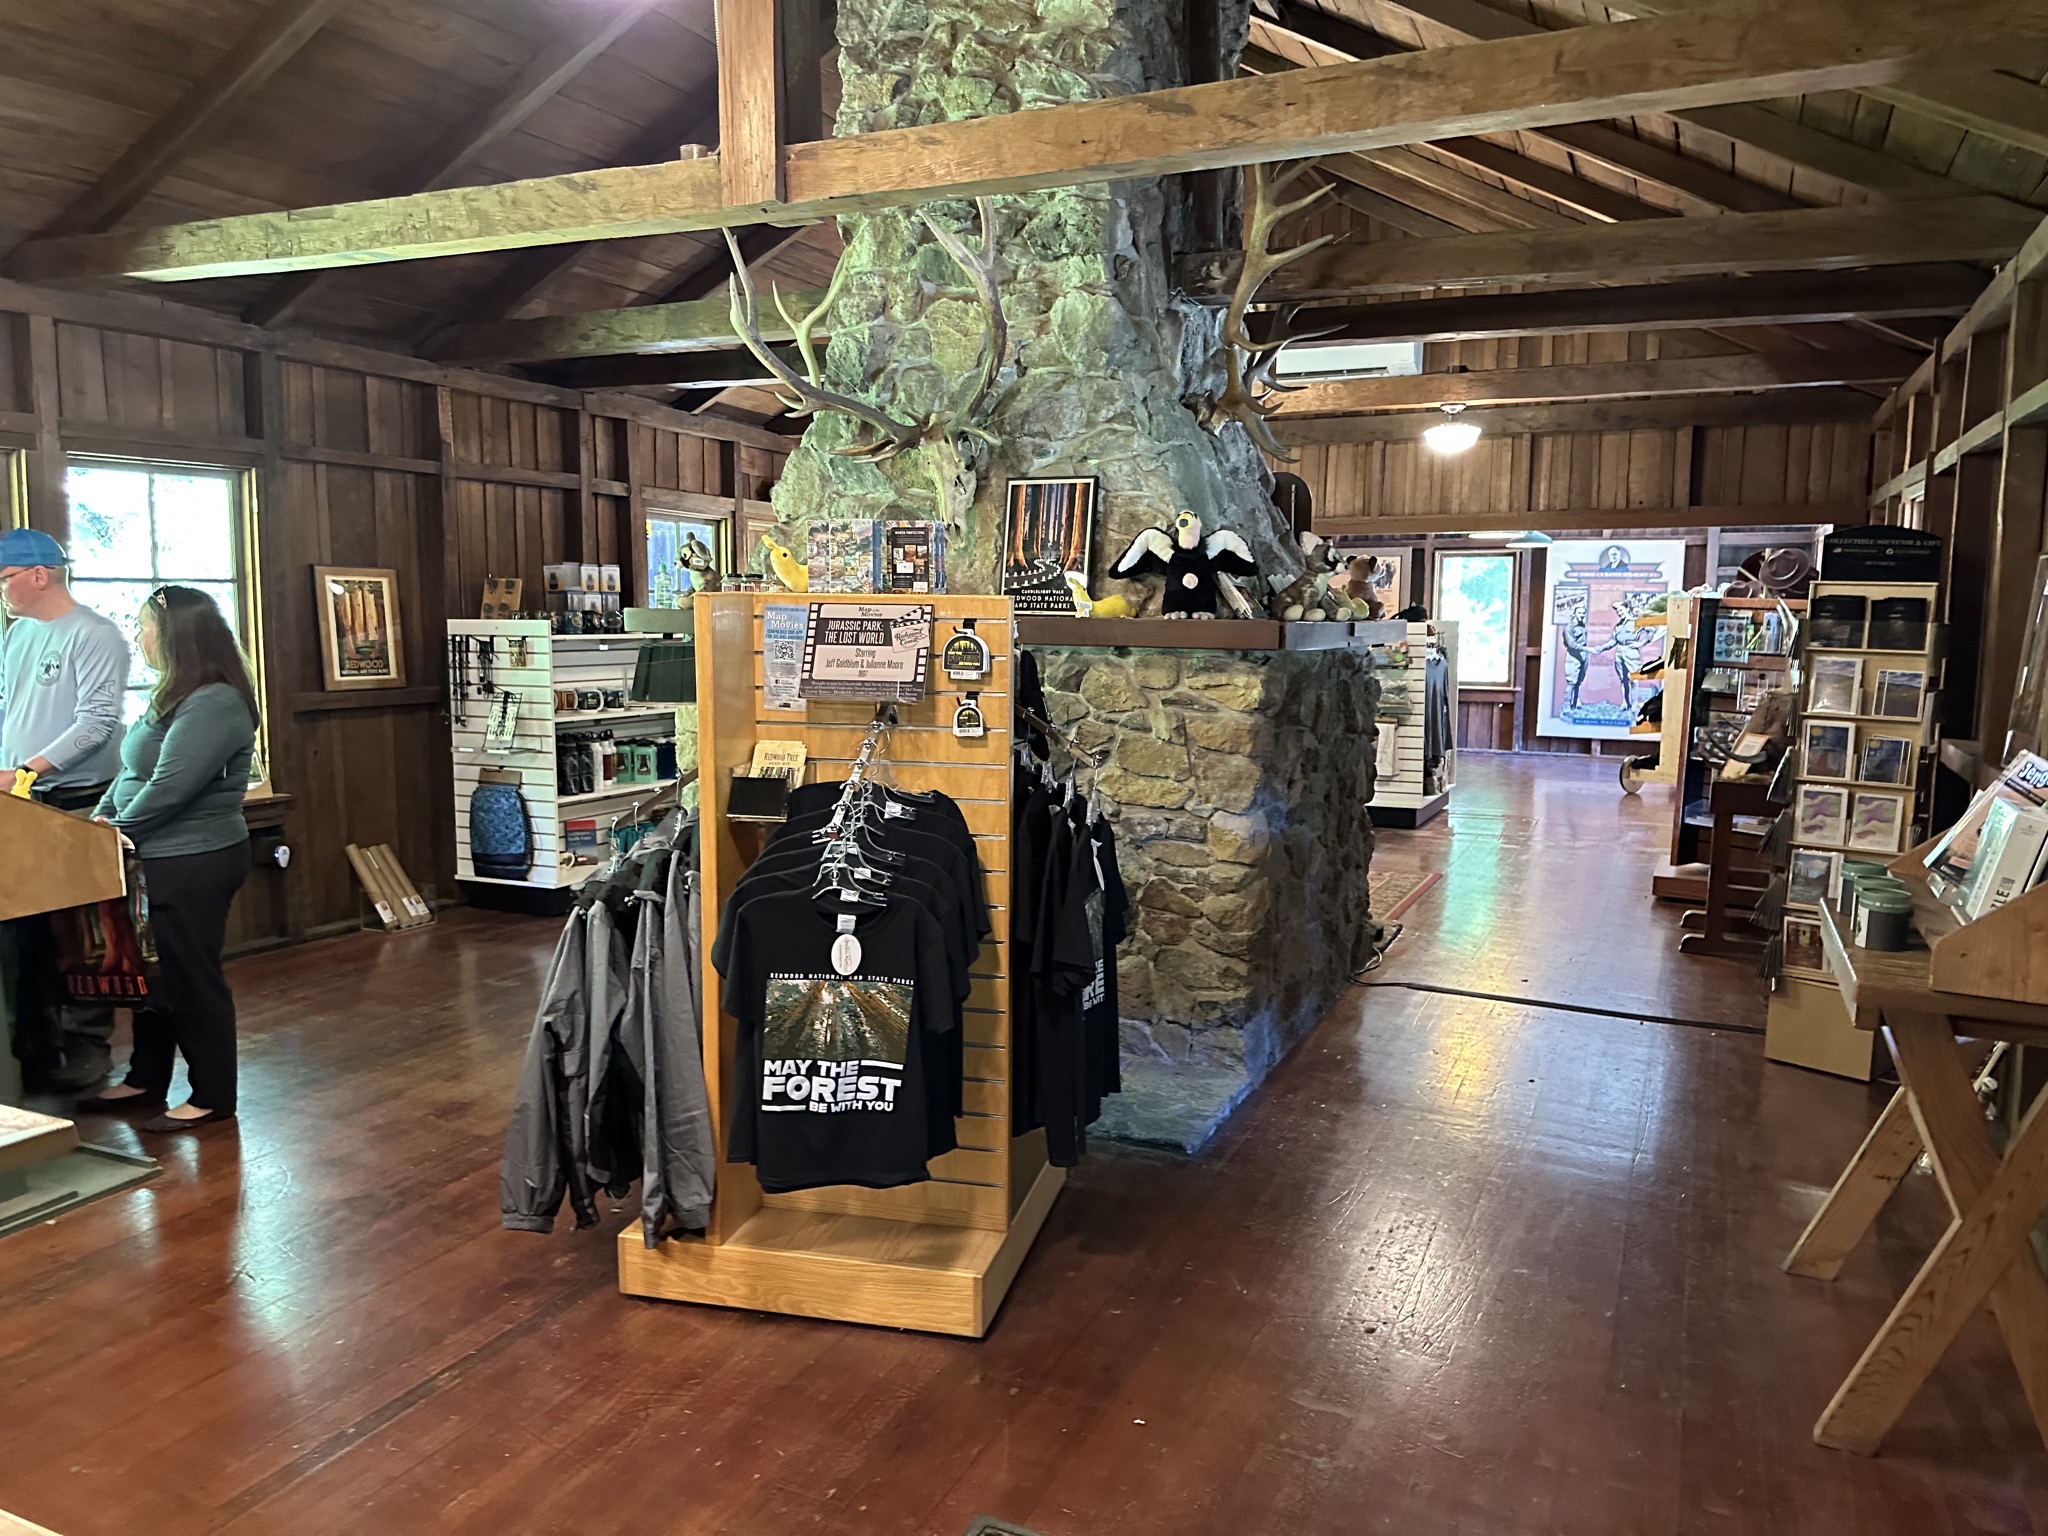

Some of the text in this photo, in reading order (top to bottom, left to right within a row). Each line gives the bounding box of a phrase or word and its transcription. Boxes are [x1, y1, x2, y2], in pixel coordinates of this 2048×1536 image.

[767, 611, 788, 621] Map
[771, 620, 804, 629] Movies
[827, 620, 884, 632] JURASSIC PARK:
[824, 631, 885, 645] THE LOST WORLD
[854, 647, 877, 659] Starring
[345, 659, 384, 669] REDWOOD
[825, 659, 904, 670] Jeff Goldblum & Julianne Moore
[2017, 761, 2048, 788] Jeng
[867, 975, 888, 983] STATE
[892, 977, 915, 986] PARKS
[763, 1059, 860, 1078] MAY THE
[762, 1075, 902, 1103] FOREST
[808, 1100, 894, 1113] BE WITH YOU
